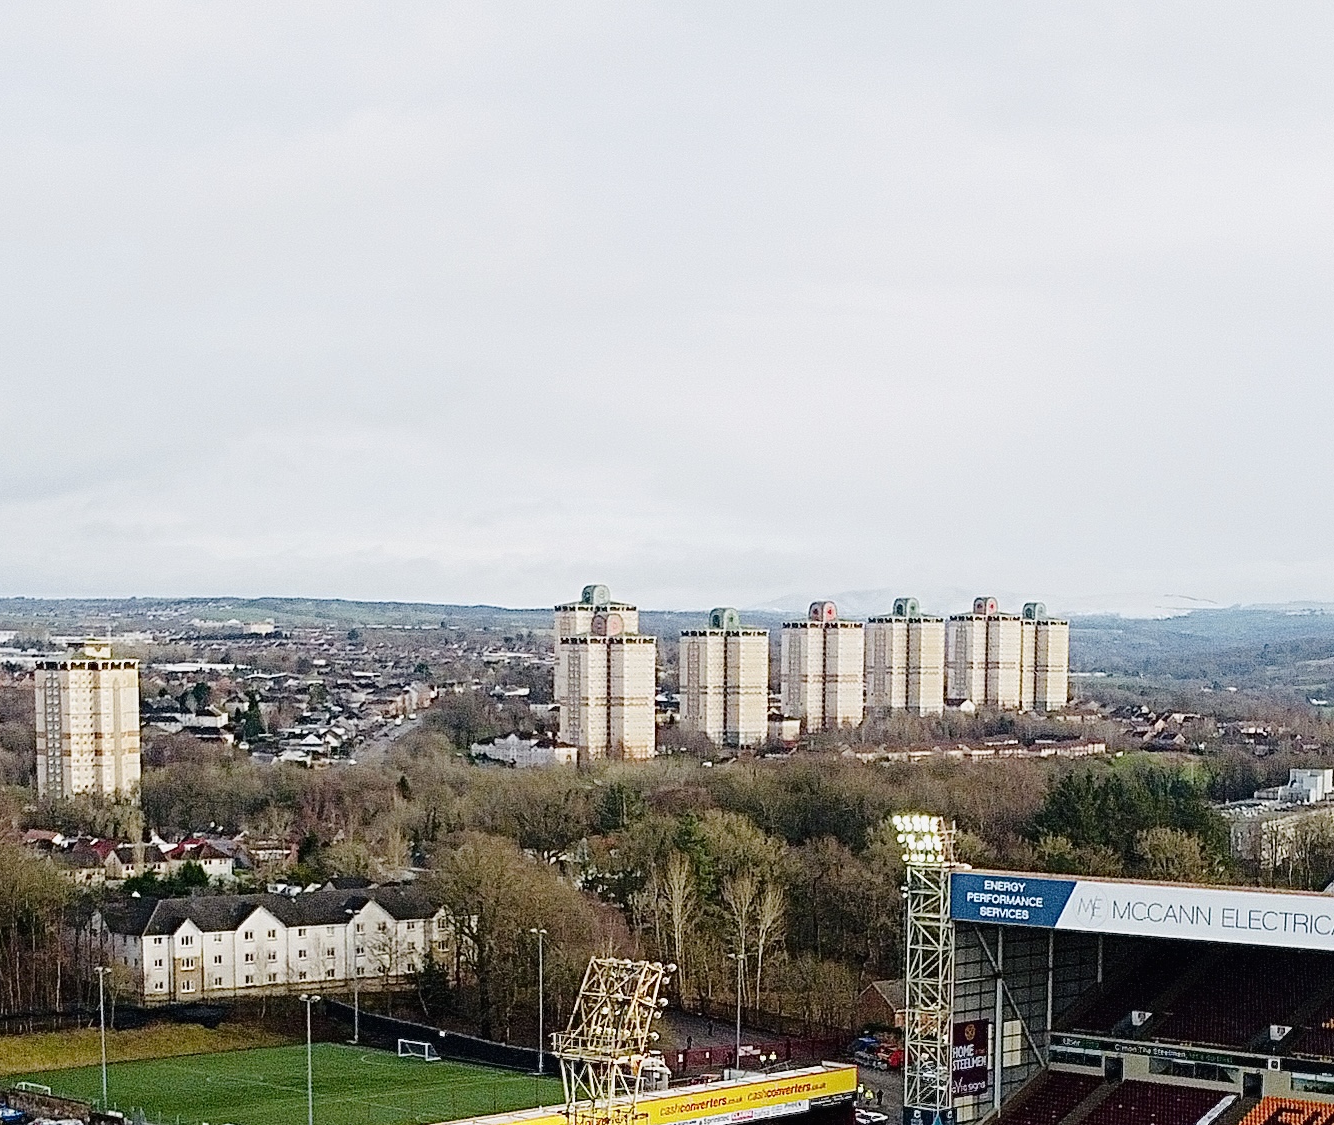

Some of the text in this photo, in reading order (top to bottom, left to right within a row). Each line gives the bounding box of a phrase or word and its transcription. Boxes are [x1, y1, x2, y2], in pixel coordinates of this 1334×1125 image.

[984, 880, 1026, 893] ENERGY
[967, 892, 1043, 908] PERFORMANCE
[980, 906, 1030, 920] SERVICES
[1112, 900, 1212, 925] MCCANN
